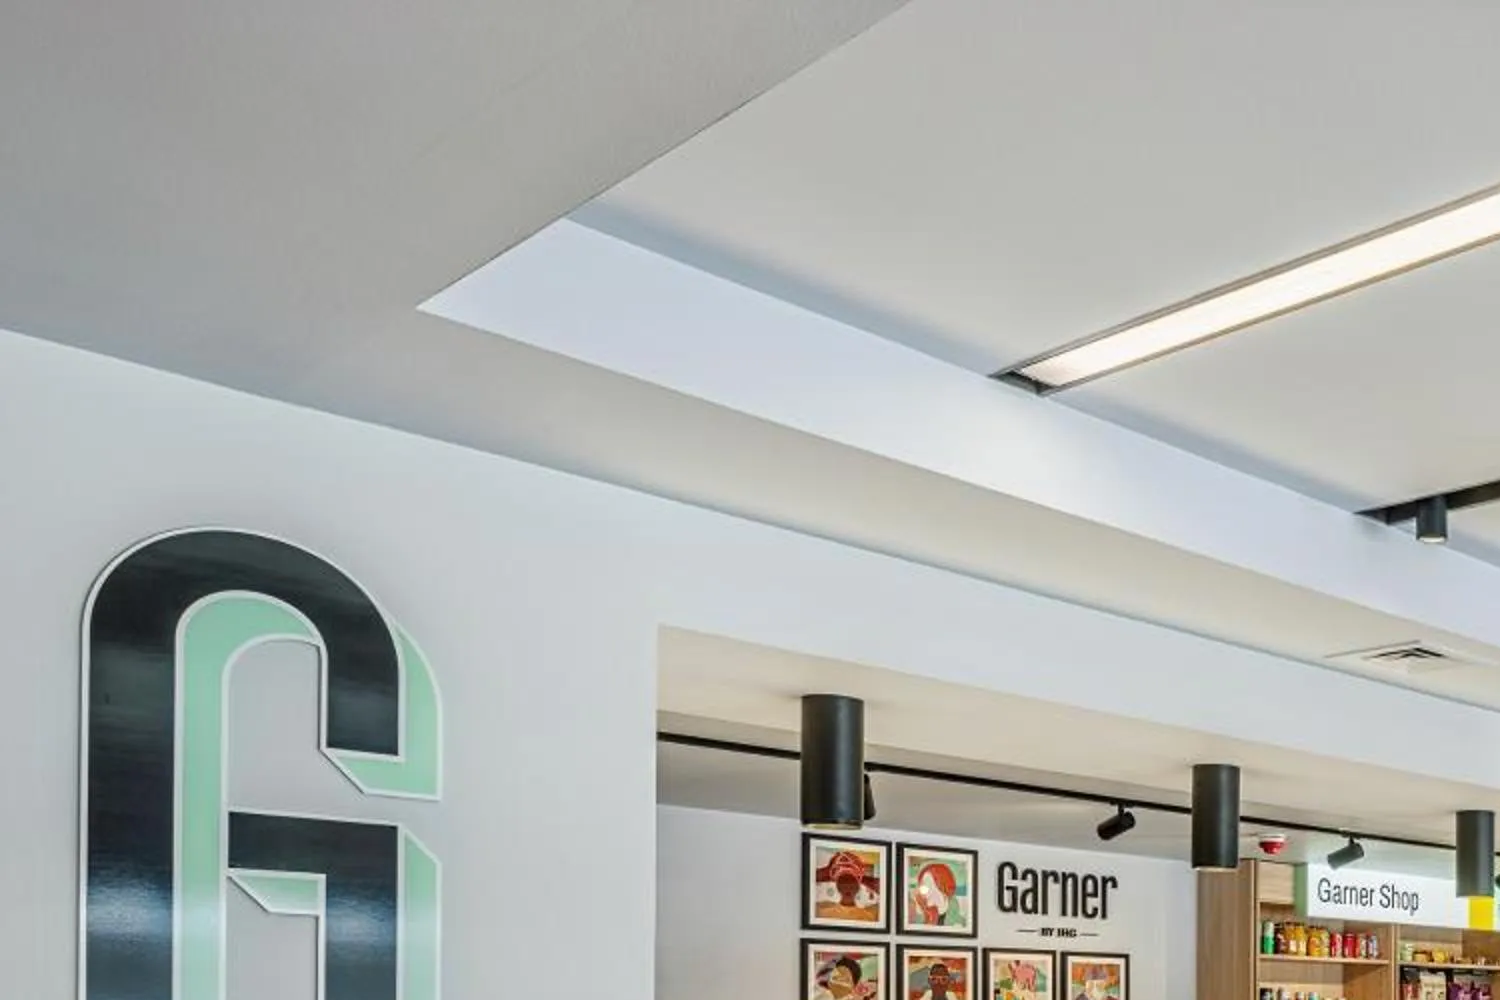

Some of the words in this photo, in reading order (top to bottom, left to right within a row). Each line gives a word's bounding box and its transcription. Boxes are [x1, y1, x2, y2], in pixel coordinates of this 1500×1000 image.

[997, 861, 1118, 920] Garner
[1317, 878, 1376, 907] Garner
[1379, 884, 1419, 916] Shop
[1041, 927, 1055, 937] BY
[1057, 927, 1077, 938] IHG
